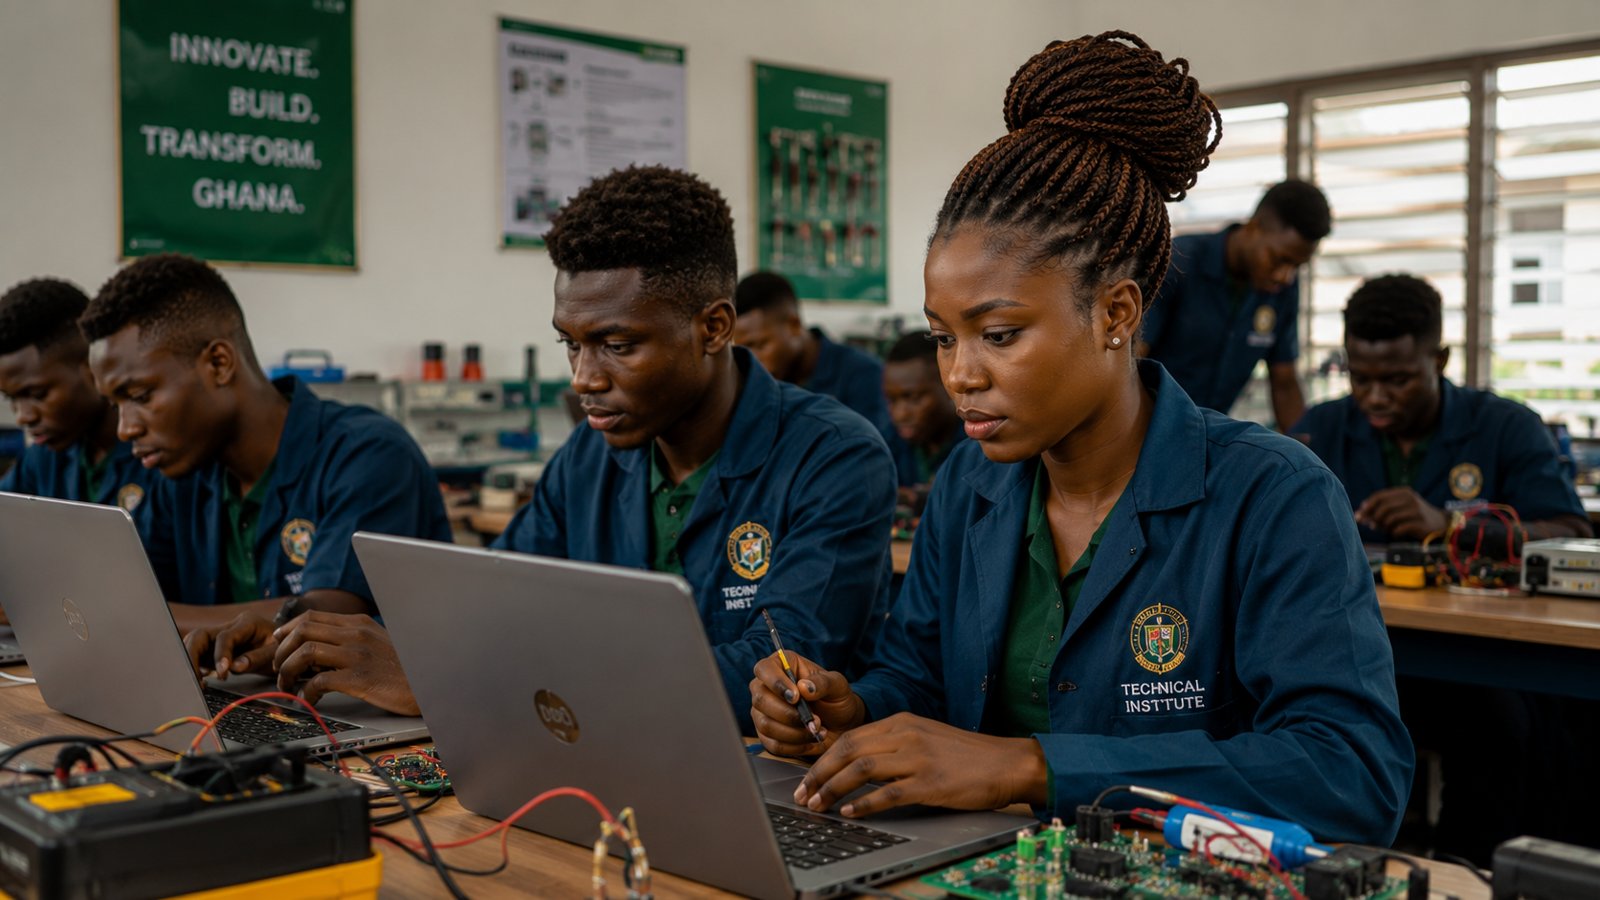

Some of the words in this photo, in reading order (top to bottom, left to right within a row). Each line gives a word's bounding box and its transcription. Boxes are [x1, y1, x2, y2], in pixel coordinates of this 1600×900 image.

[170, 32, 319, 79] INNOVATE.
[229, 86, 319, 124] BUILD.
[140, 125, 321, 169] TRANSFORM.
[193, 178, 304, 213] GHANA.
[1121, 680, 1205, 696] TECHNICAL
